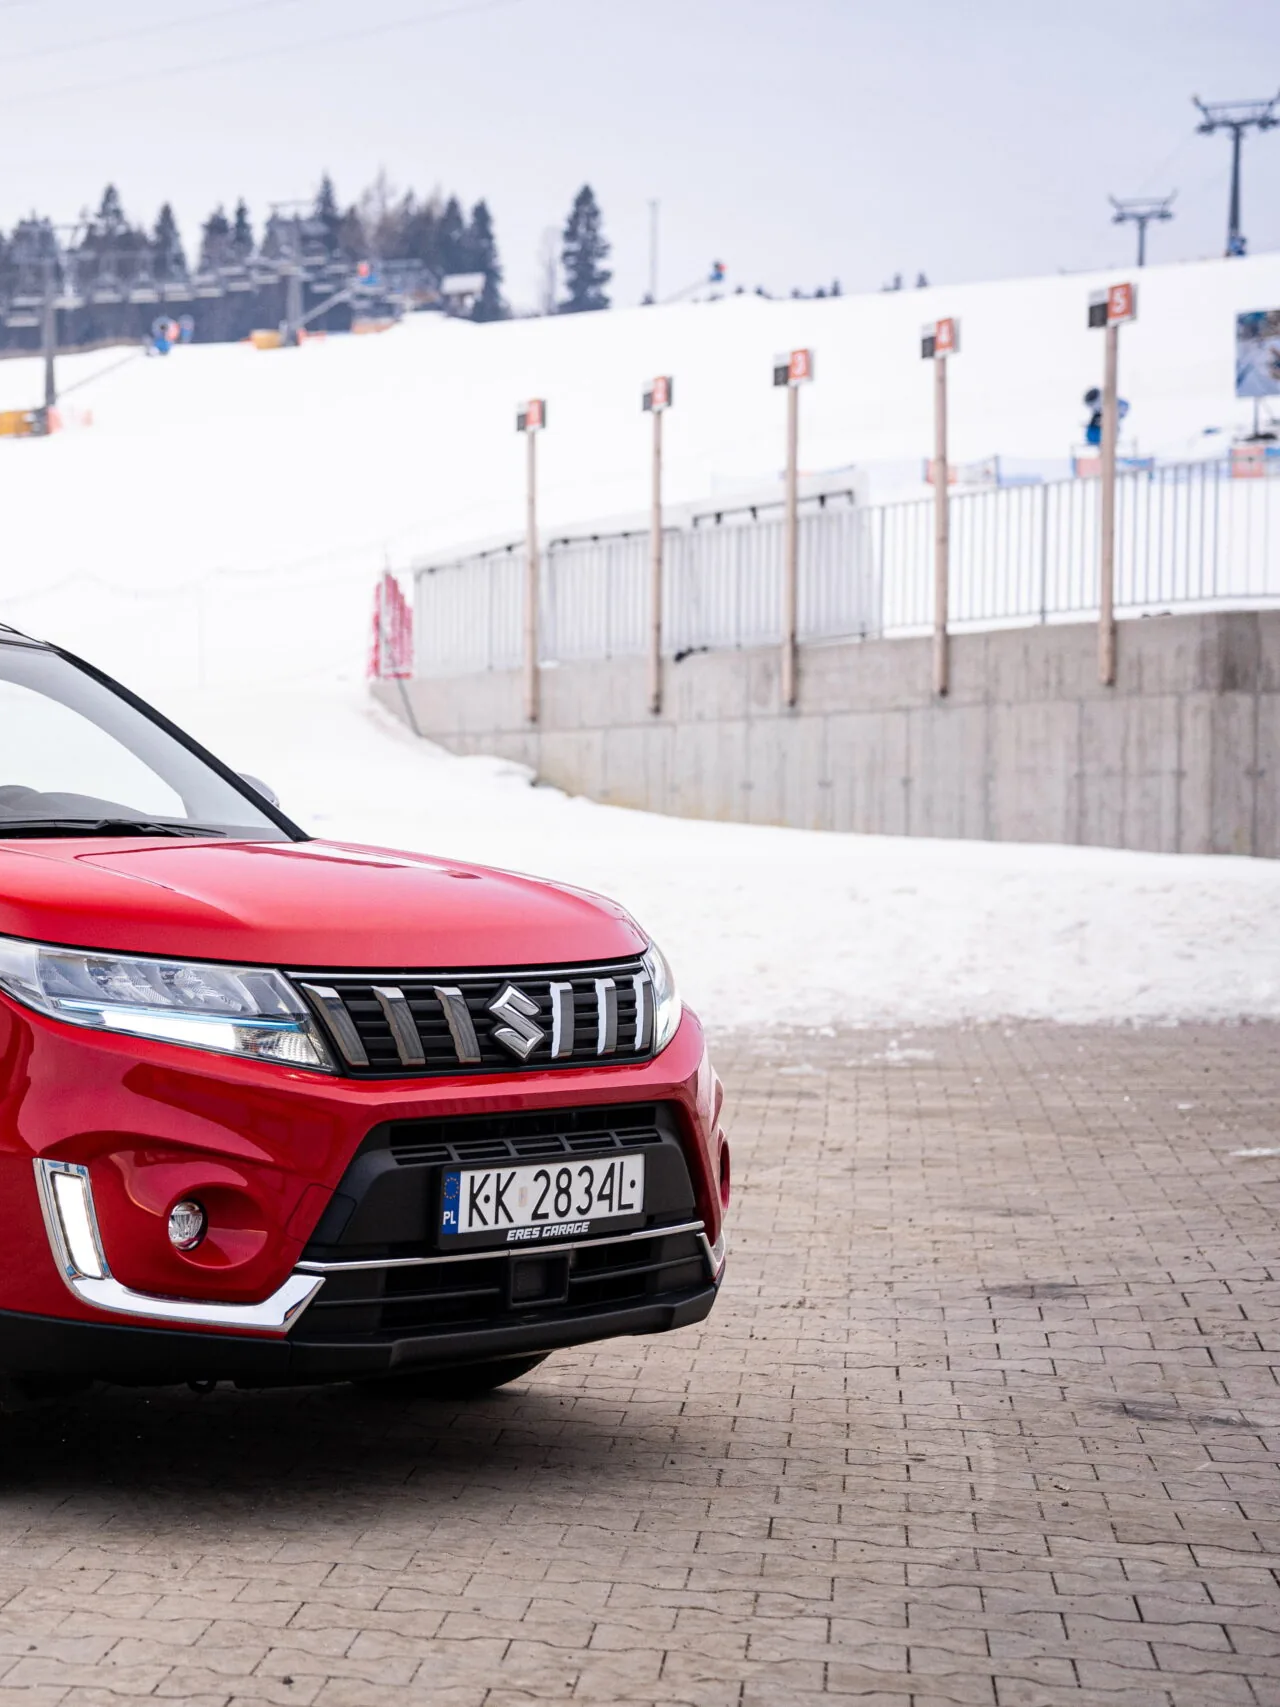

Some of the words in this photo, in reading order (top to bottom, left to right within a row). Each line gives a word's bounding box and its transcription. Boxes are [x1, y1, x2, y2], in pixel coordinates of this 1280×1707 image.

[443, 1211, 457, 1225] PL
[506, 1226, 540, 1241] ERES
[542, 1221, 590, 1238] GARAGE
